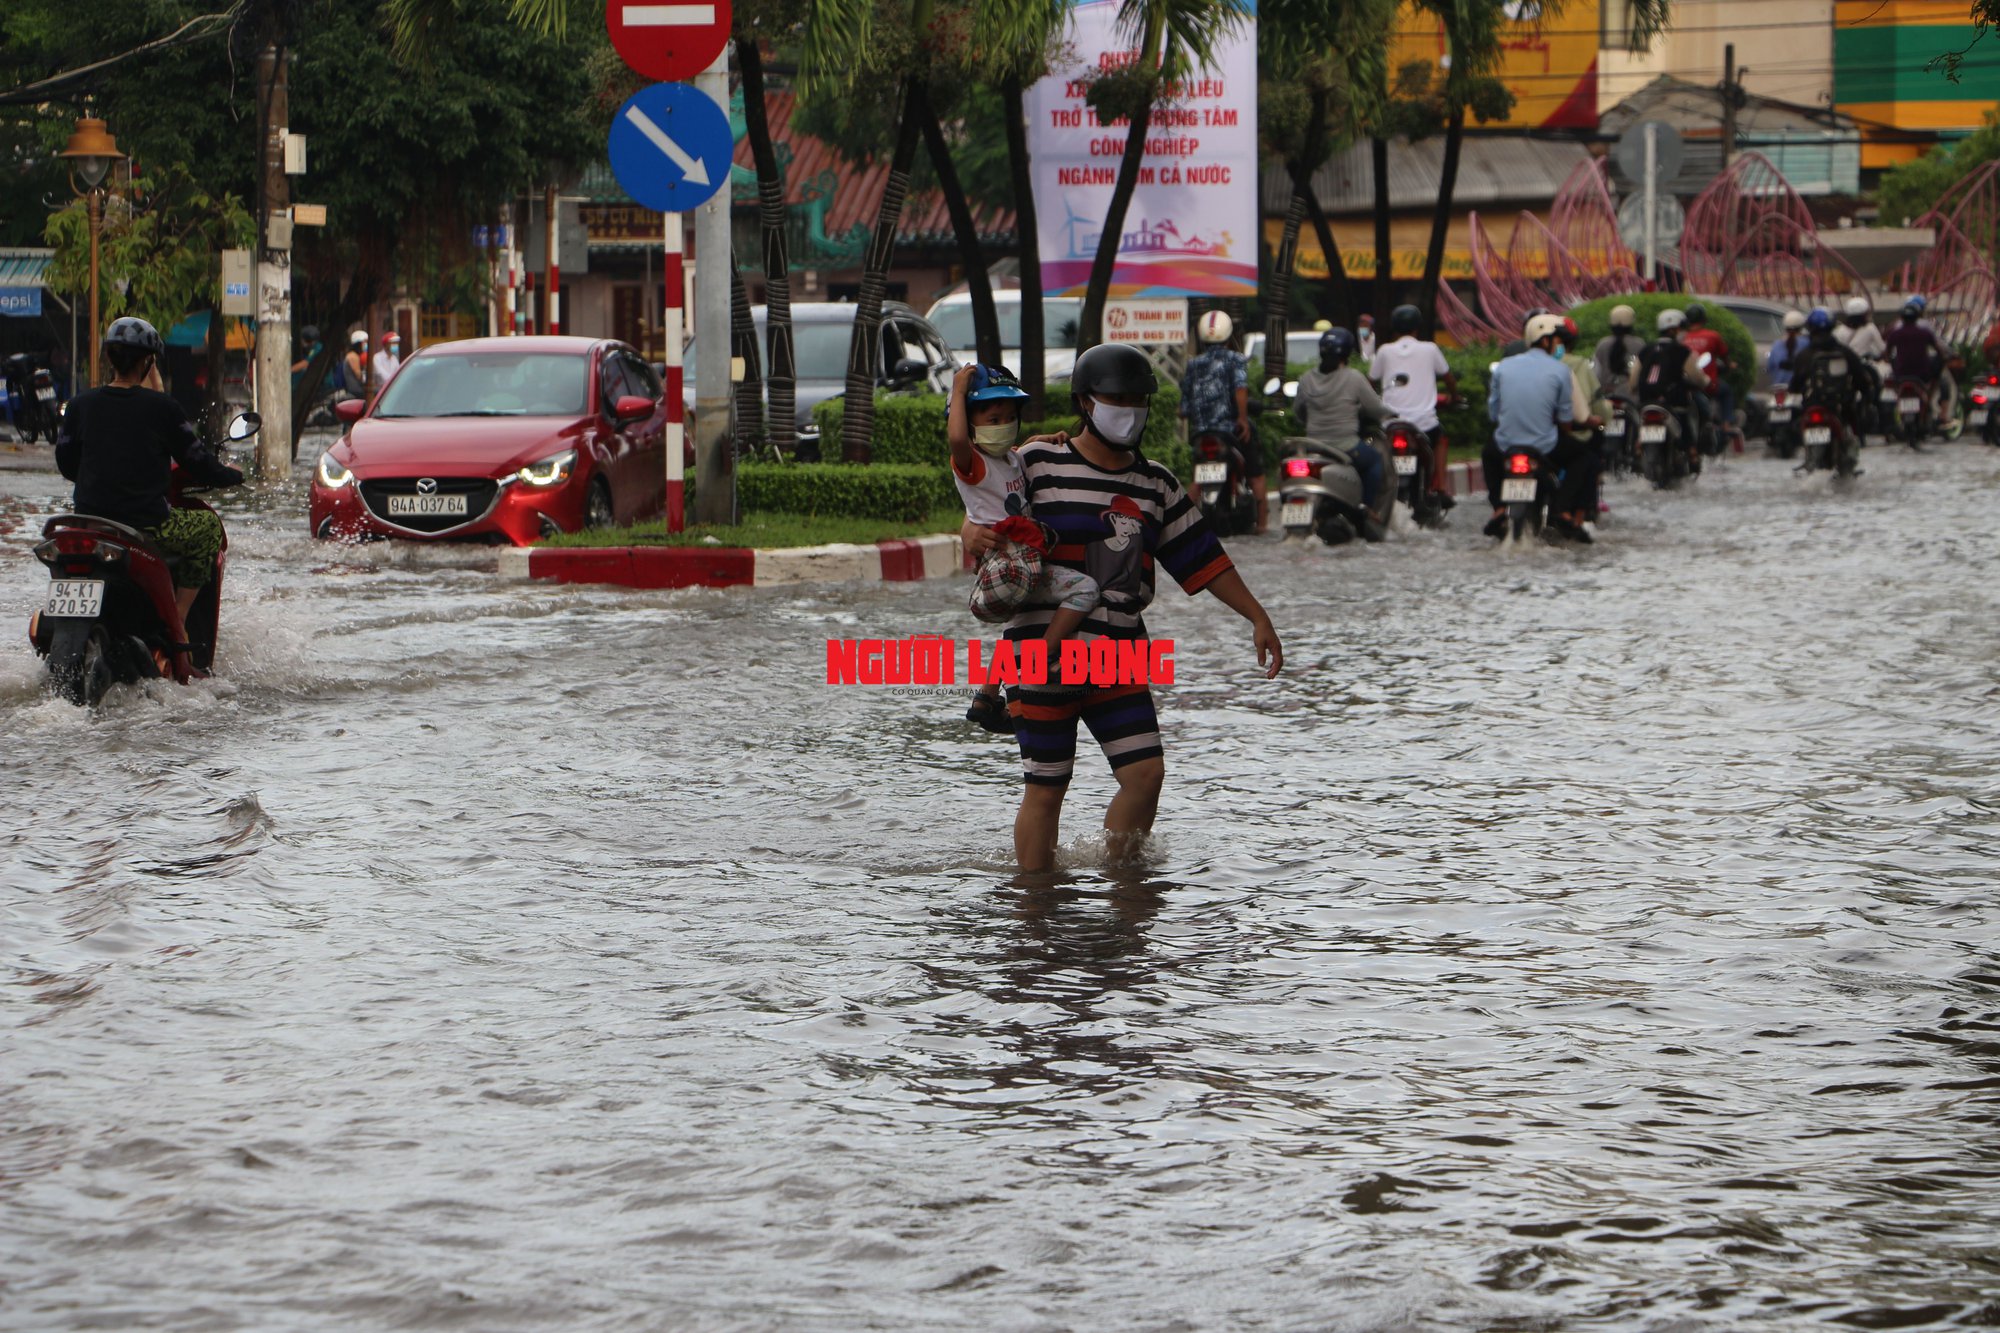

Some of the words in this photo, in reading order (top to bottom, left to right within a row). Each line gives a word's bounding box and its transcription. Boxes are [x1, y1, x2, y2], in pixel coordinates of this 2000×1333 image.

[1051, 104, 1082, 127] TRỞ
[1204, 105, 1238, 126] TÂM
[1090, 134, 1125, 156] CÔN
[1058, 163, 1116, 185] NGÀNH
[1160, 161, 1181, 185] CẢ
[1187, 163, 1232, 185] NƯỚC
[55, 583, 95, 598] 94-K1
[48, 599, 98, 615] 820.52
